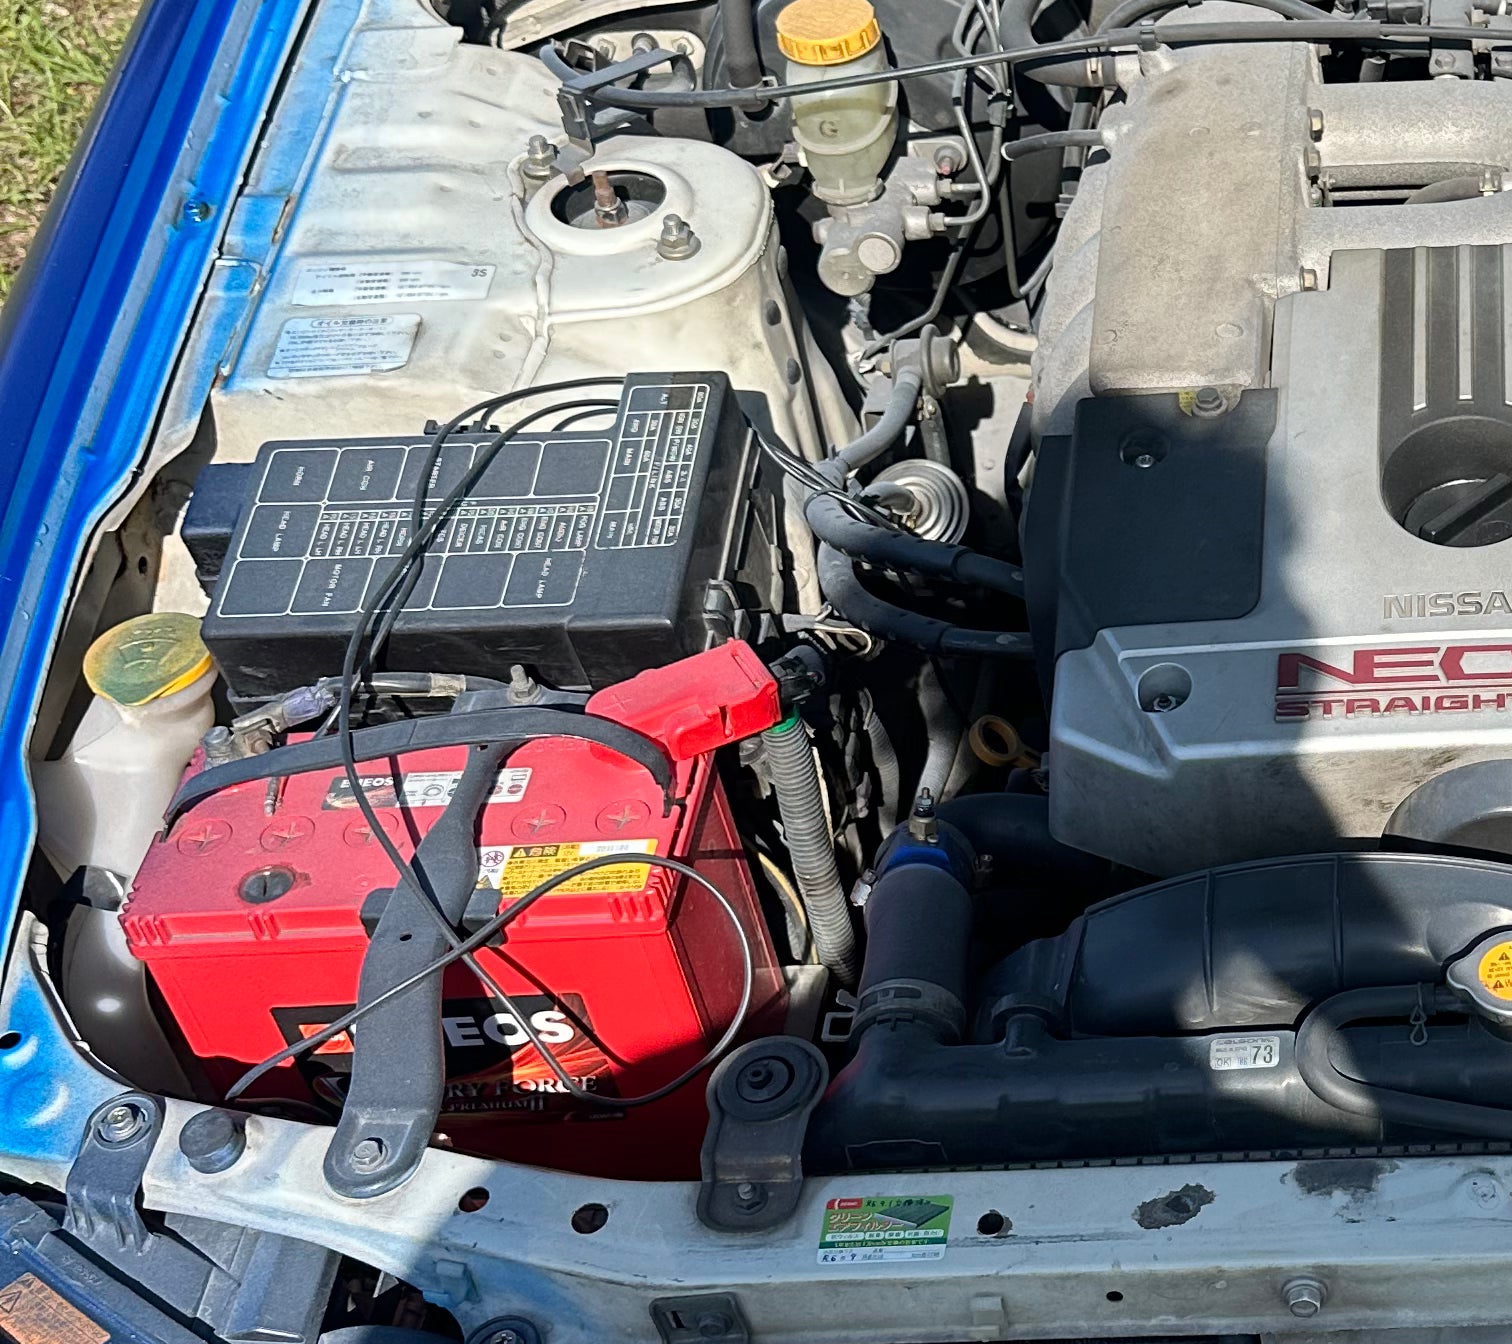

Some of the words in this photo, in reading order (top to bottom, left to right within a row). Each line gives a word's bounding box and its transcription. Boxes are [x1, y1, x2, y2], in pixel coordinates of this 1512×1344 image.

[278, 510, 292, 531] HEAD
[540, 557, 553, 578] HEAD
[535, 578, 548, 600] LAMP
[1251, 1044, 1274, 1065] 73
[827, 1221, 905, 1233] エアフィルター
[828, 1212, 873, 1223] クリーン
